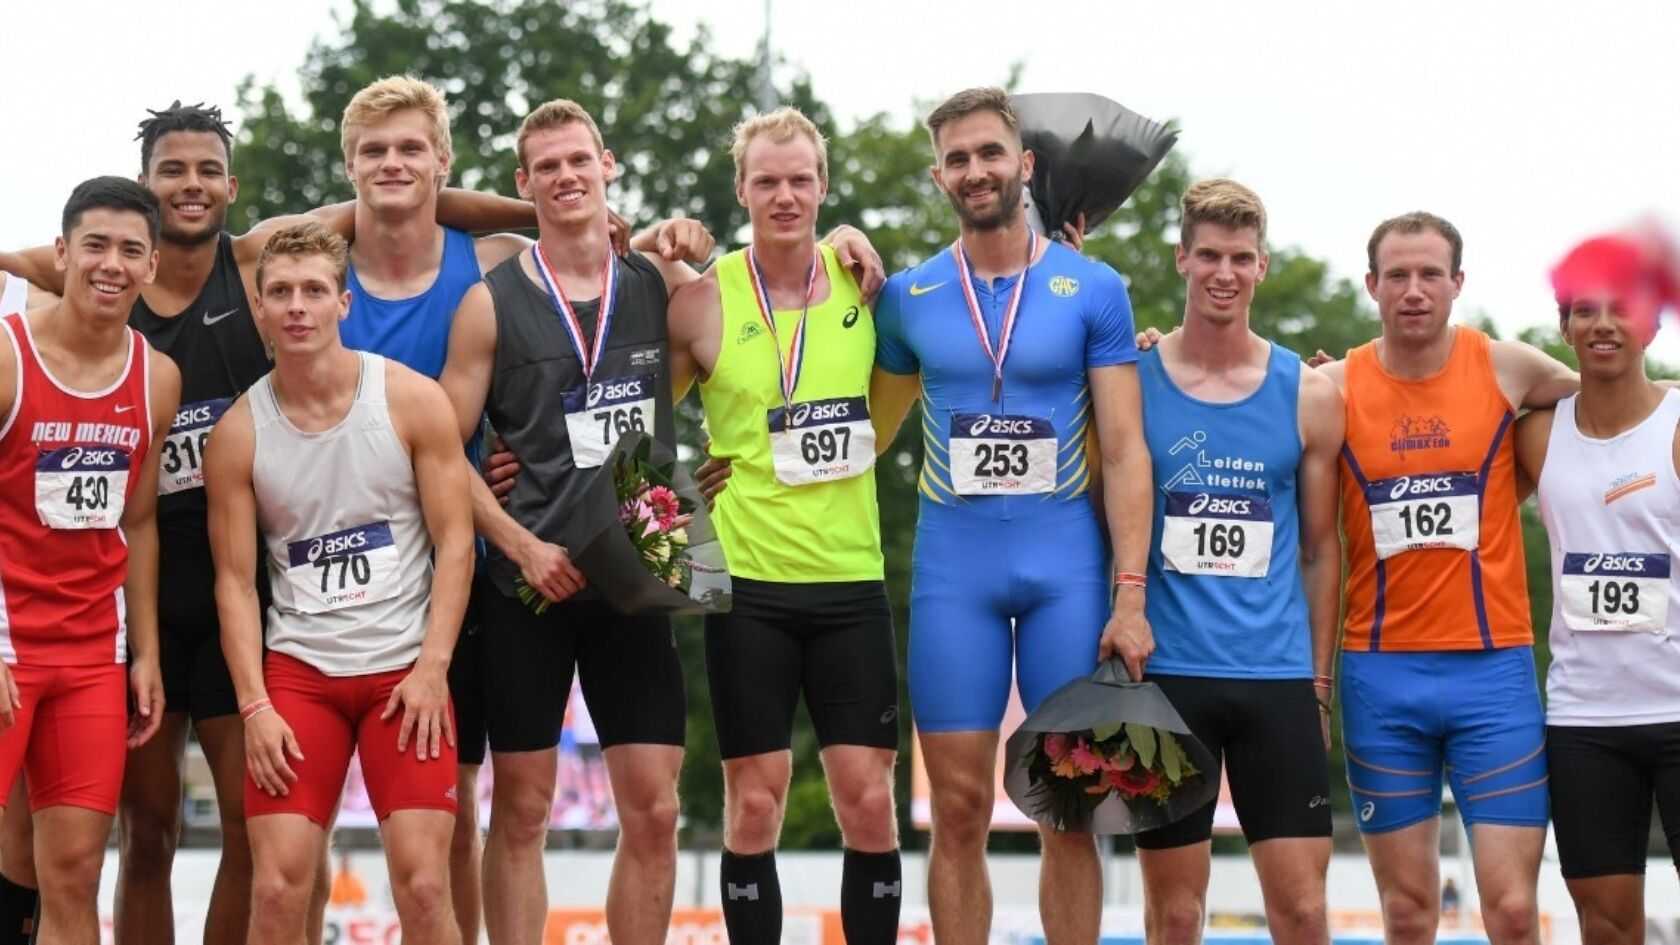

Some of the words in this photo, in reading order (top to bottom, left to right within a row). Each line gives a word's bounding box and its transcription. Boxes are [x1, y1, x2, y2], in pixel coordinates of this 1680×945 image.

[604, 380, 641, 400] asics
[811, 402, 849, 420] asics
[31, 421, 72, 442] NEW
[74, 422, 141, 448] MEXICO
[594, 406, 645, 445] 766
[990, 418, 1033, 435] asics
[81, 451, 116, 466] asics
[801, 426, 851, 466] 697
[974, 443, 1029, 477] 253
[66, 475, 109, 510] 430
[1410, 476, 1453, 494] asics
[1208, 496, 1251, 515] asics
[1398, 501, 1454, 538] 162
[325, 531, 367, 553] asics
[1193, 522, 1246, 558] 169
[313, 554, 371, 593] 770
[1602, 556, 1645, 571] asics
[1588, 579, 1640, 614] 193
